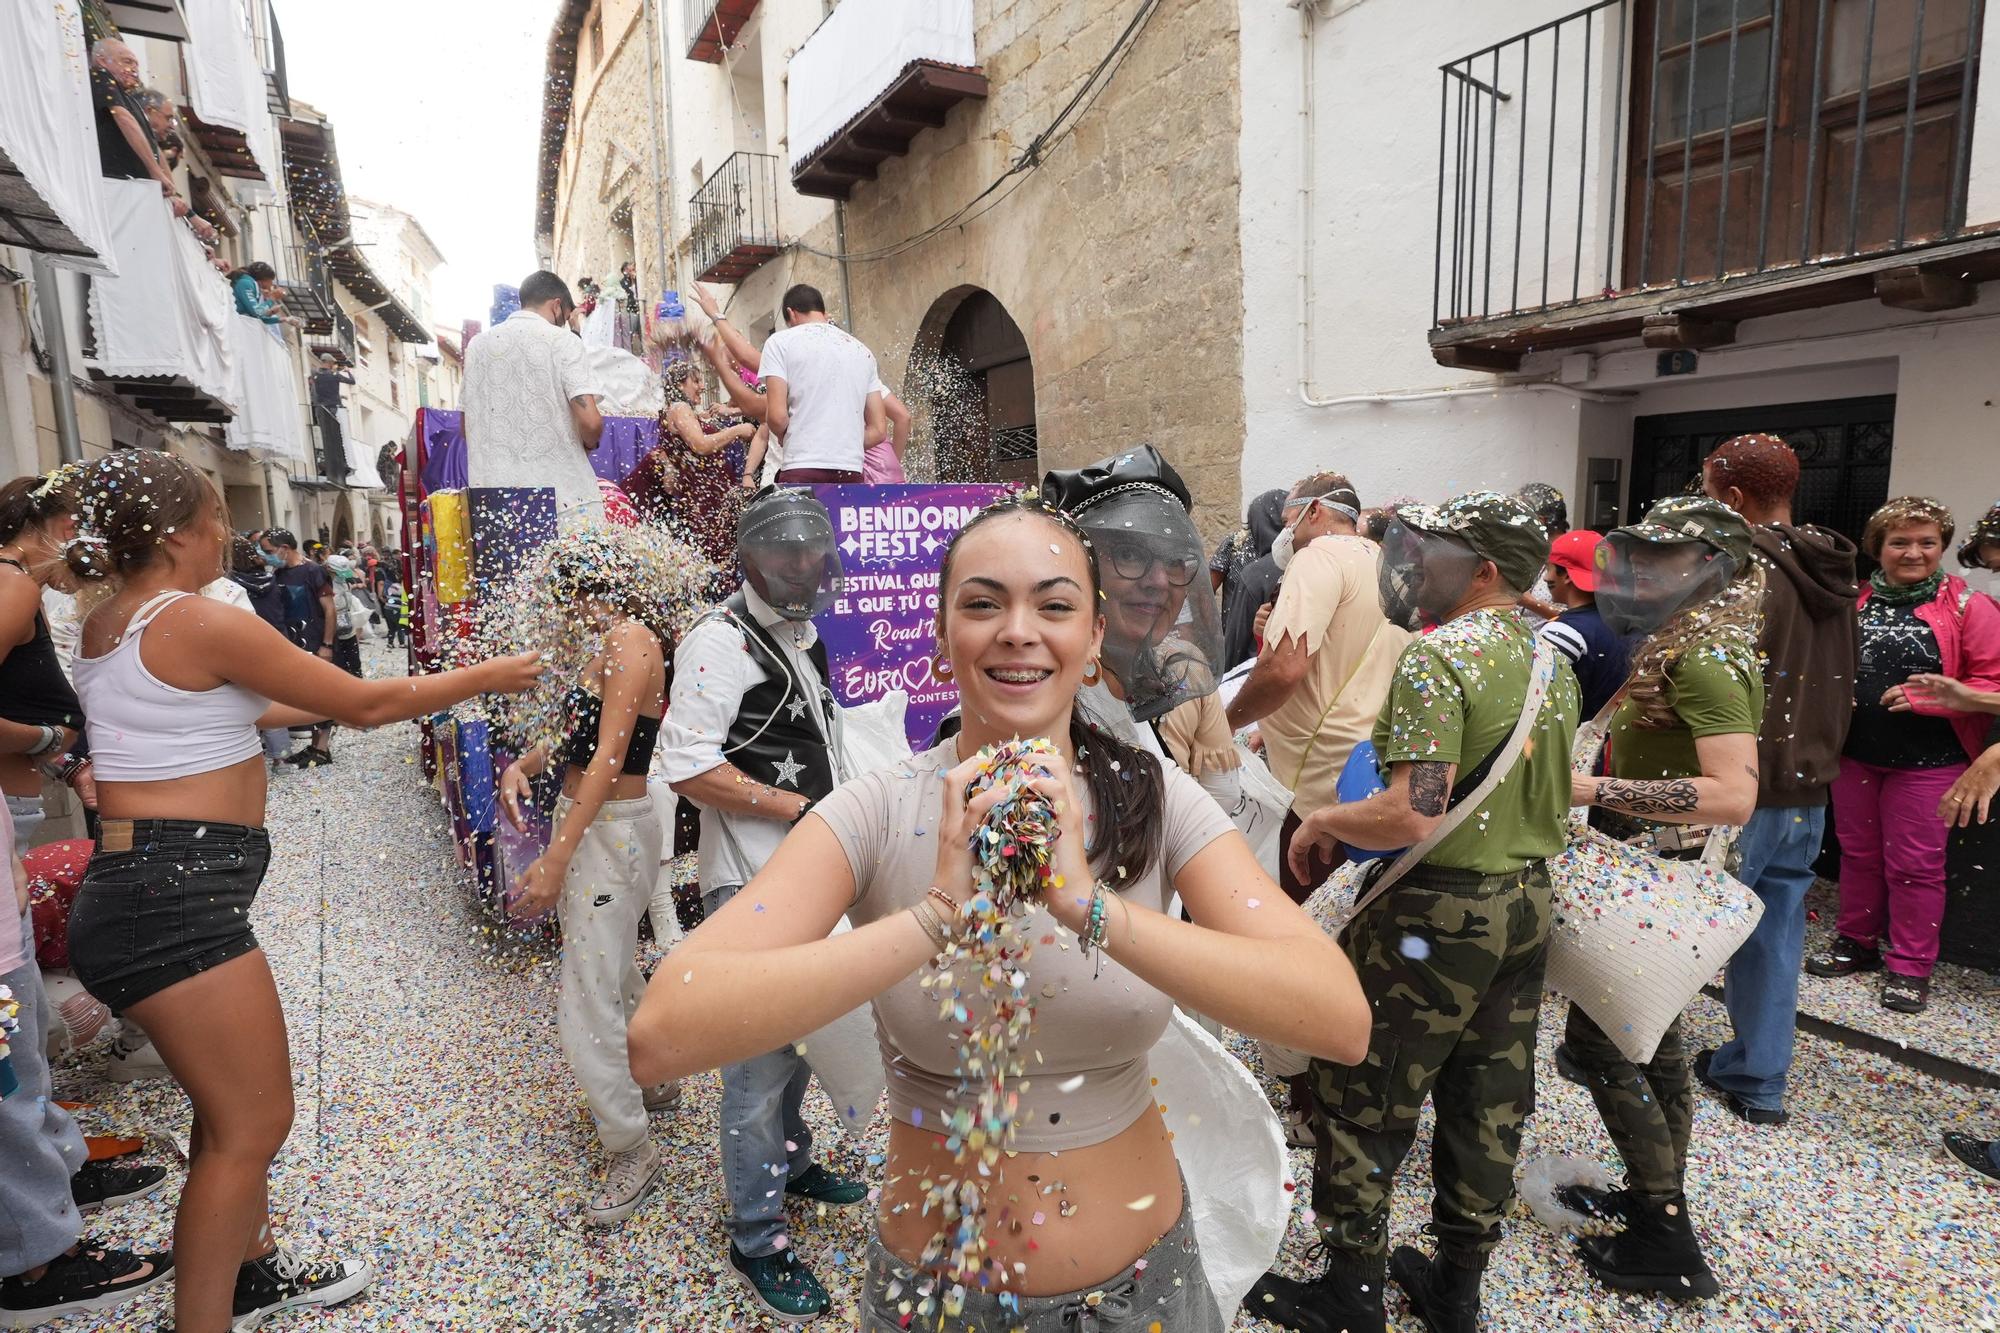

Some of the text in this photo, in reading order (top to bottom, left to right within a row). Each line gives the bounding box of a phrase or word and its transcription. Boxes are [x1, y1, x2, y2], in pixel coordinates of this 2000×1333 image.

[1672, 352, 1682, 371] 6
[839, 506, 980, 532] BENIDORM
[859, 530, 921, 557] FEST
[831, 574, 905, 593] FESTIVAL
[834, 598, 853, 614] EL
[857, 595, 893, 613] QUE
[898, 590, 920, 611] TÚ
[869, 617, 922, 651] Road
[909, 690, 960, 704] CONTEST
